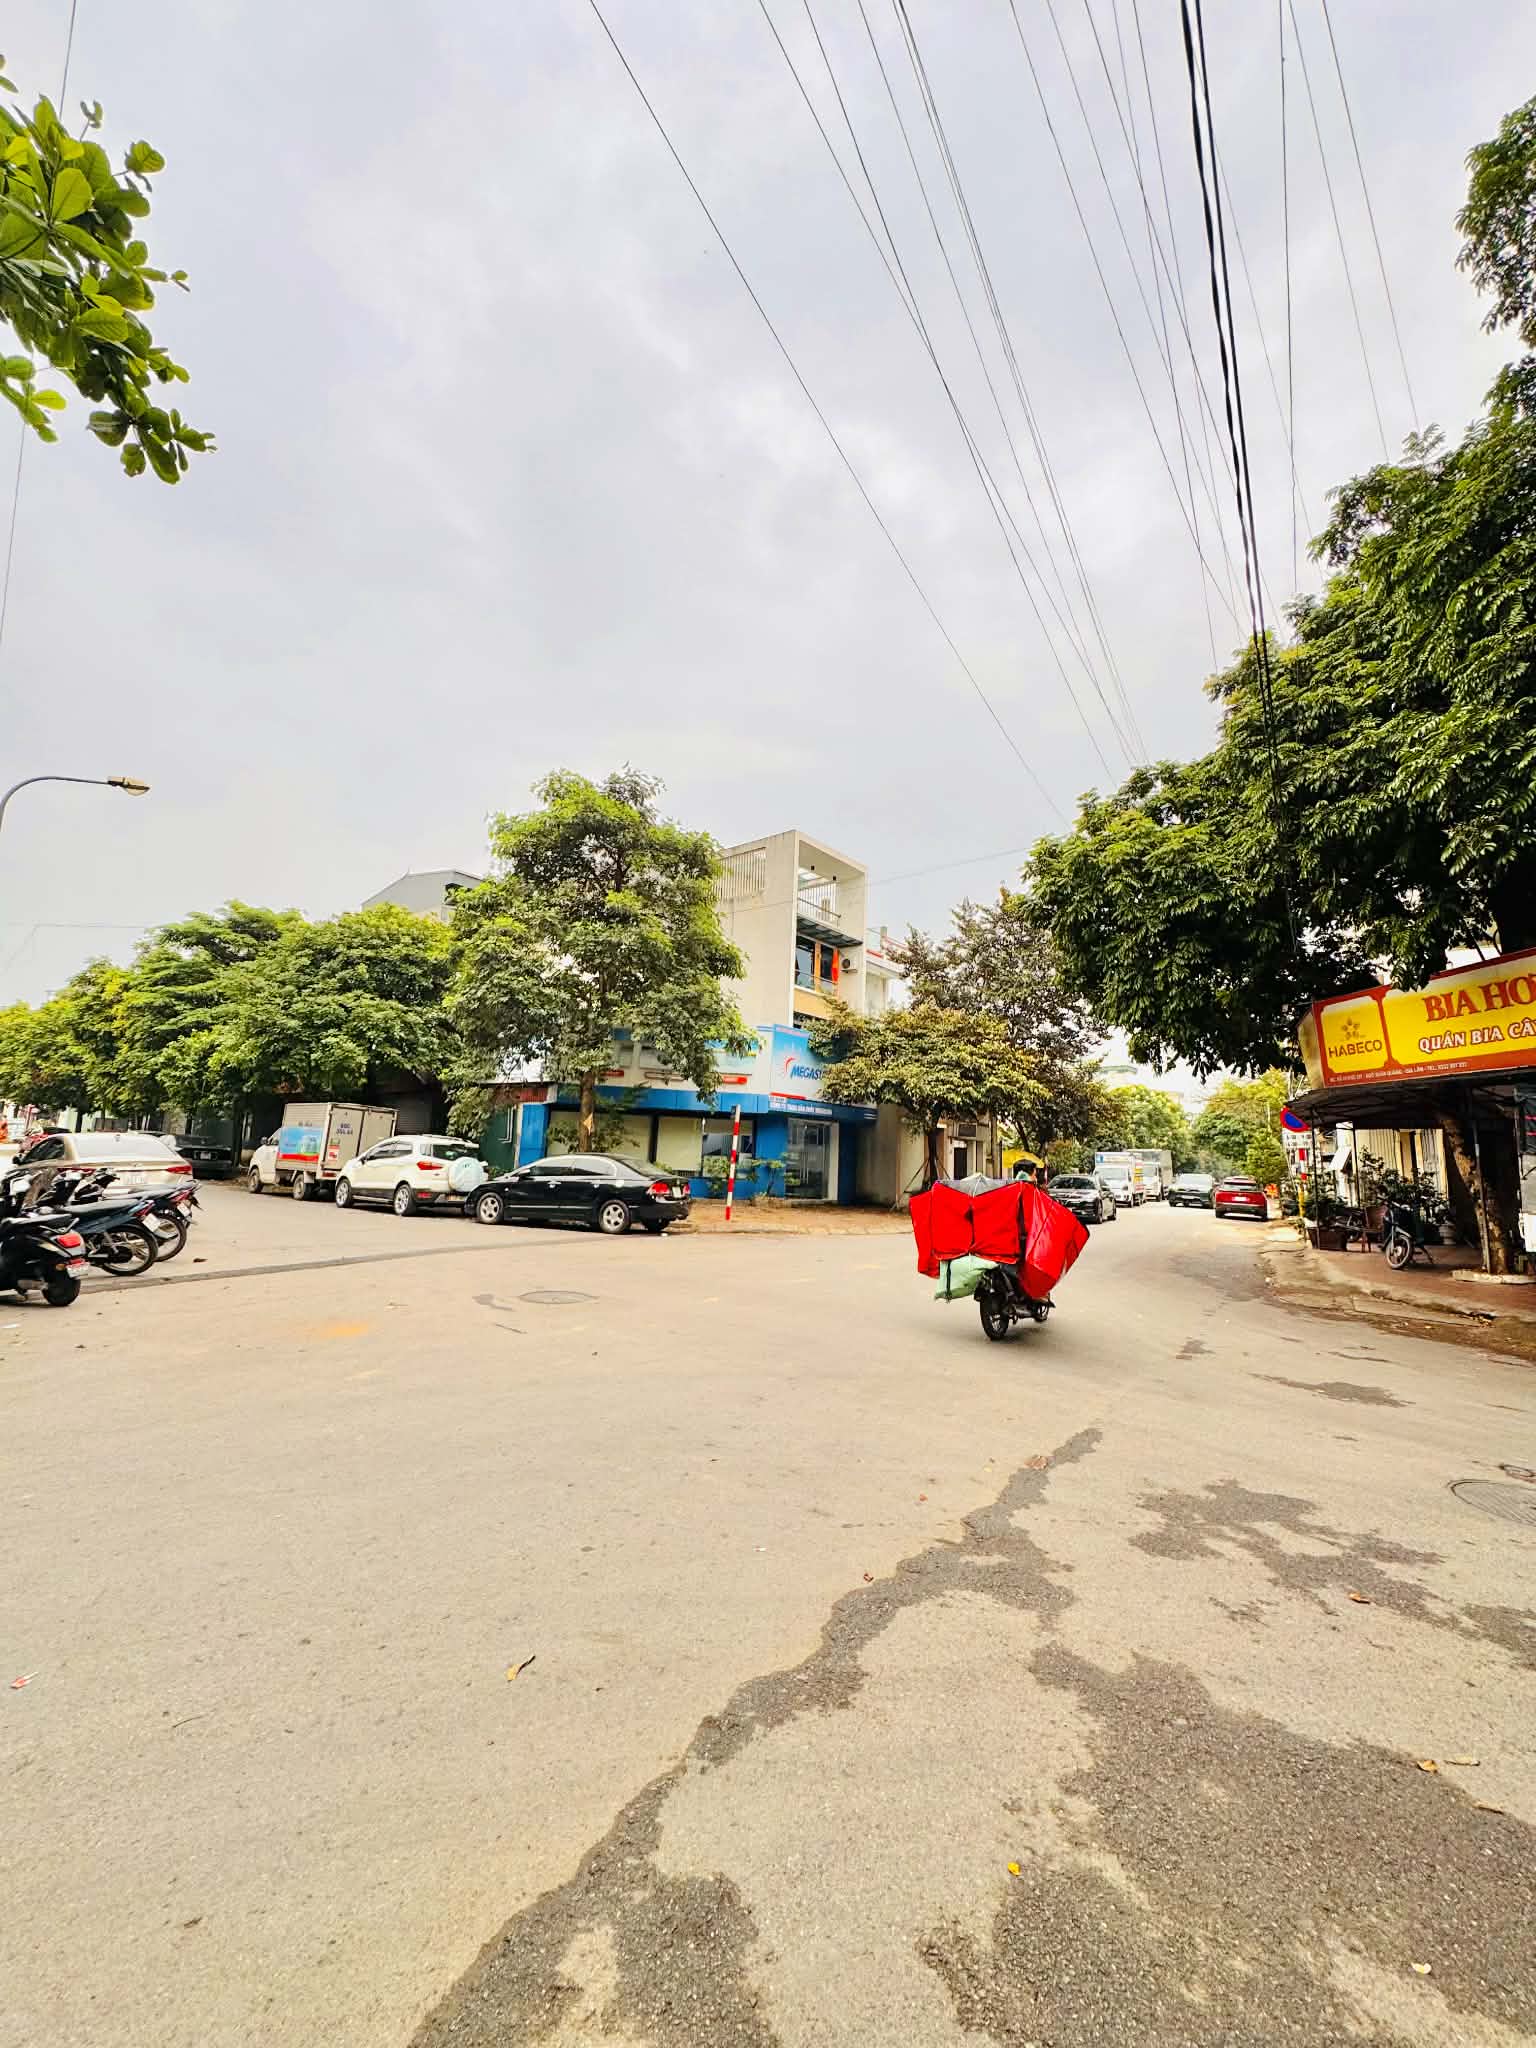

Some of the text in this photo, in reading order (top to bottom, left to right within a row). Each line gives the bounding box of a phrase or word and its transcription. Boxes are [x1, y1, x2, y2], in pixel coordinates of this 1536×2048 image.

[1422, 990, 1481, 1022] BIA
[1328, 1039, 1383, 1058] HABECO
[1419, 1016, 1536, 1054] QUÁN BIA CÂ
